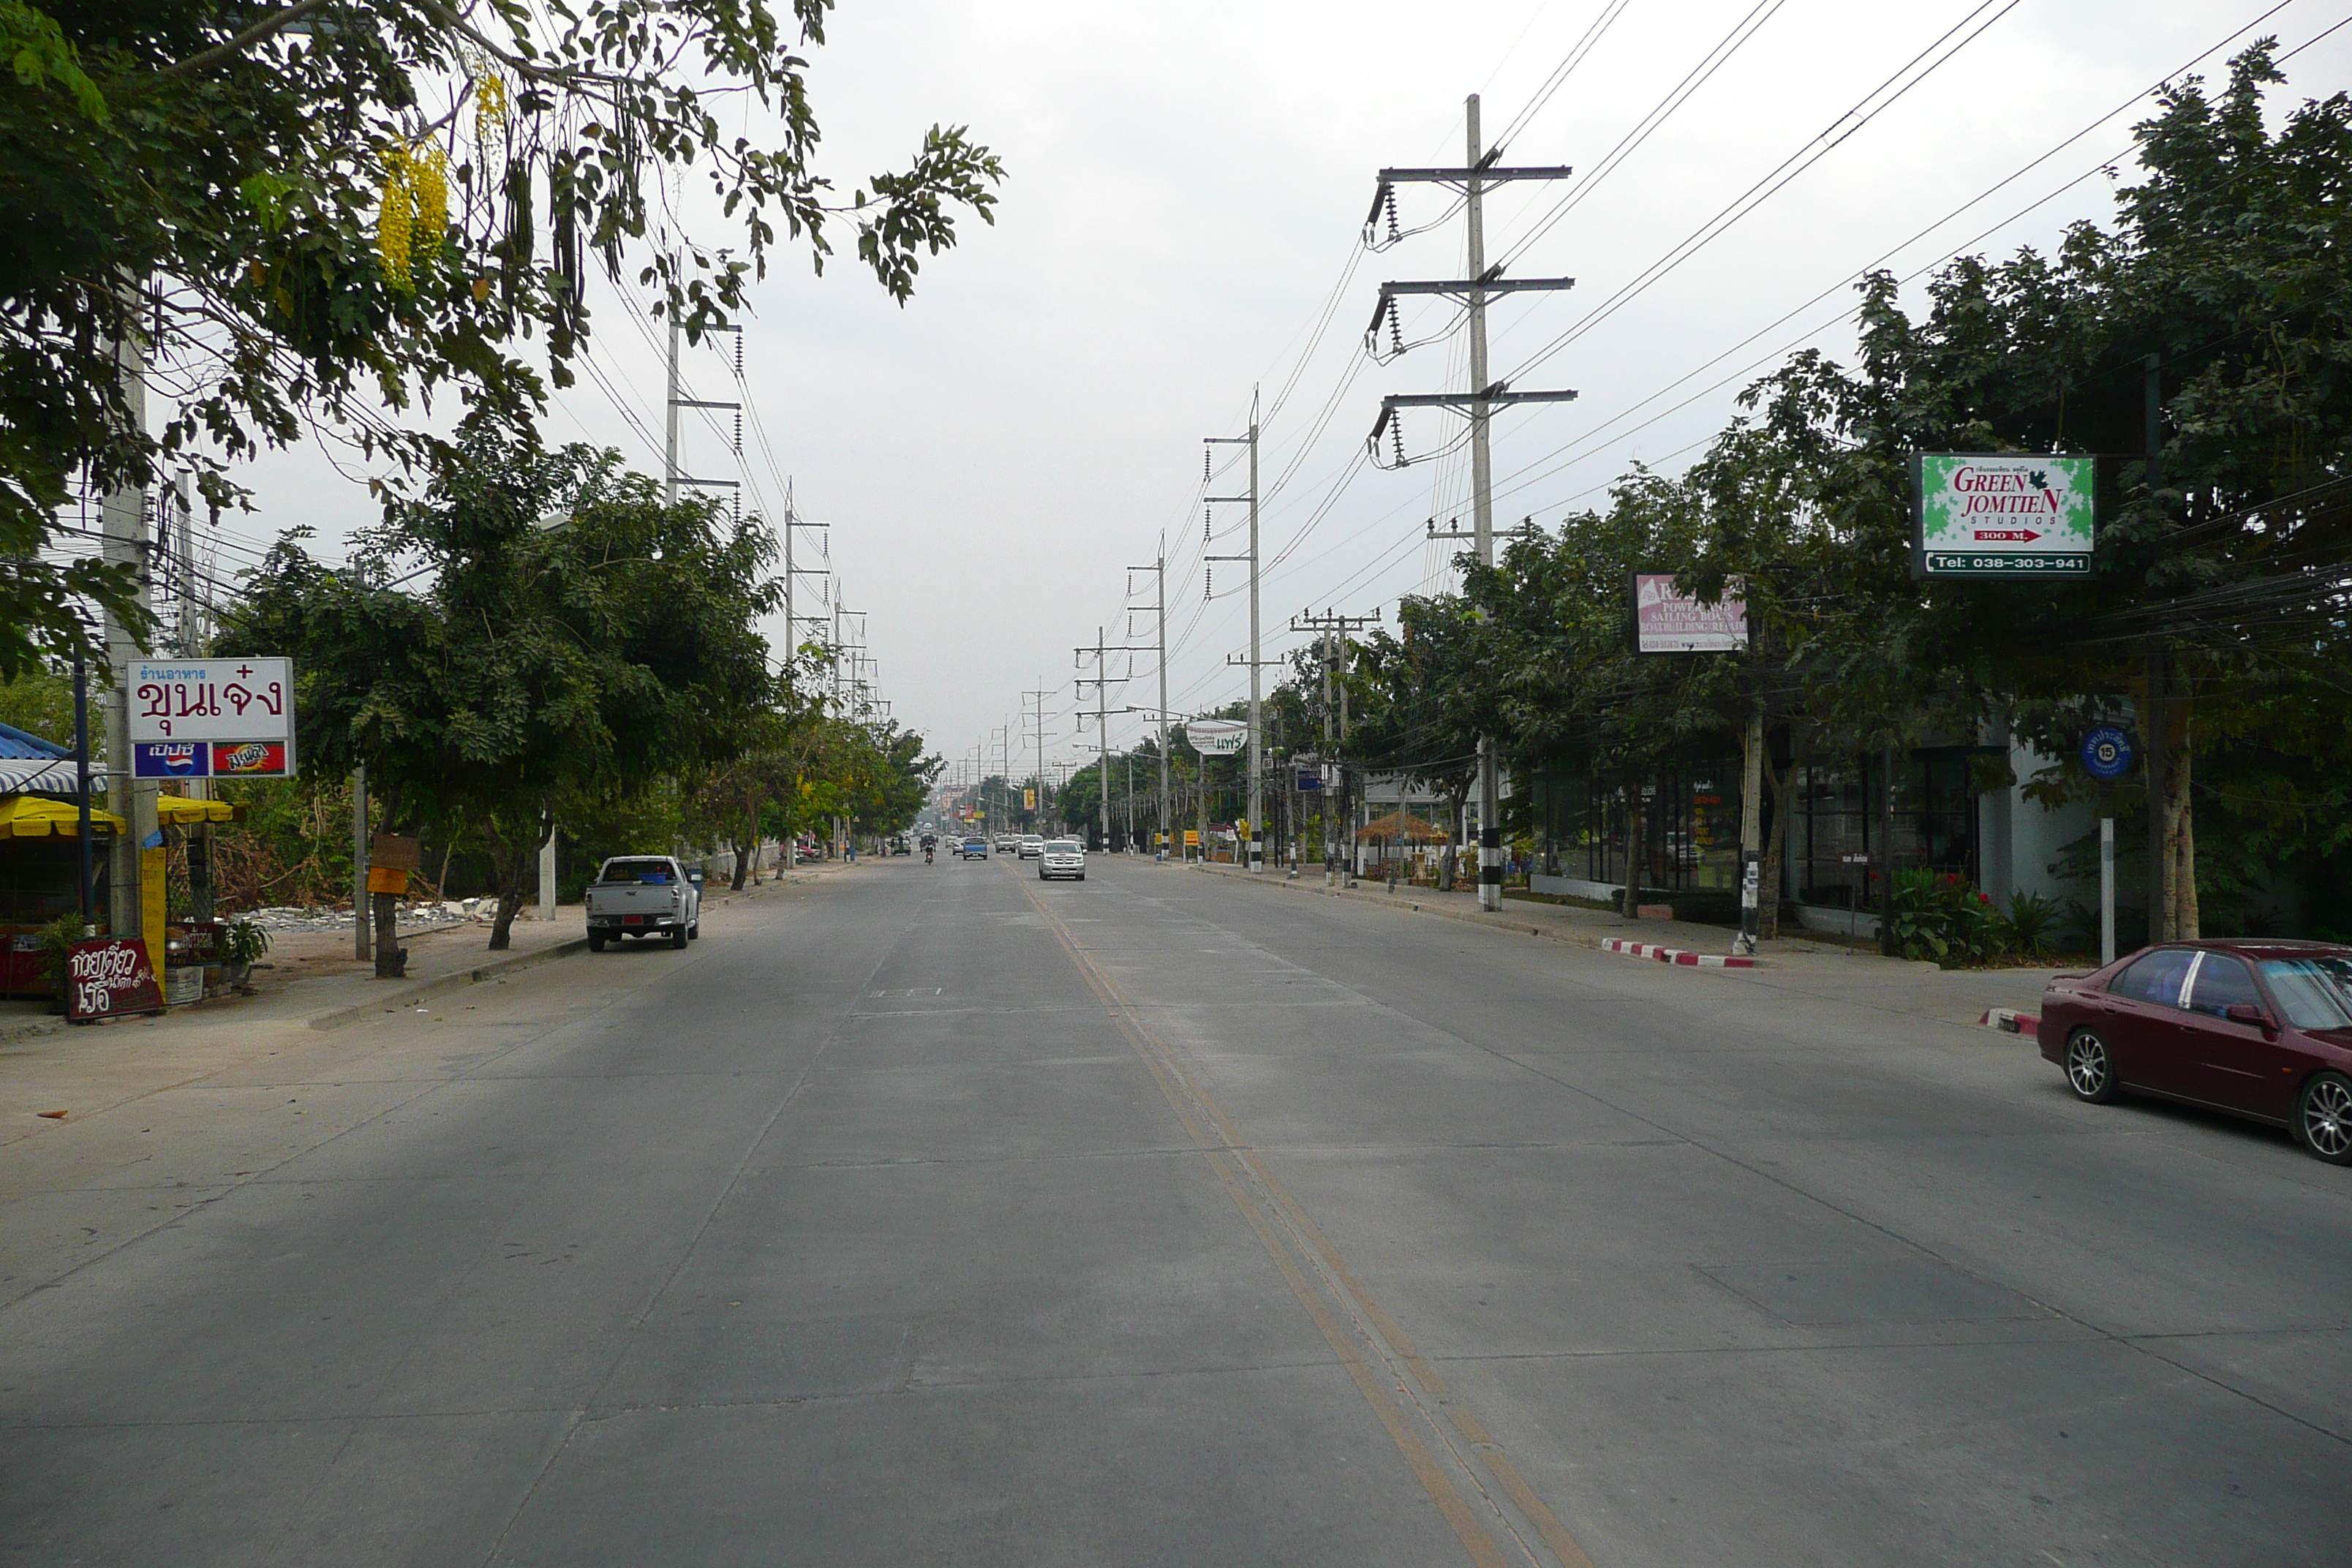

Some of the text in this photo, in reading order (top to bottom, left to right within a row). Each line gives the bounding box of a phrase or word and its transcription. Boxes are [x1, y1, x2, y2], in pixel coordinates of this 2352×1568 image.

[1961, 489, 2063, 517] JOMTIEN
[1979, 532, 2029, 540] 300 M.
[1936, 557, 2084, 568] Tel: 038-303-941
[1651, 612, 1697, 622] SAILING
[140, 666, 206, 680] ร้านอาหาร
[137, 664, 282, 736] ขุนเจ๋ง
[2100, 747, 2113, 758] 15
[78, 981, 109, 1014] เรือ
